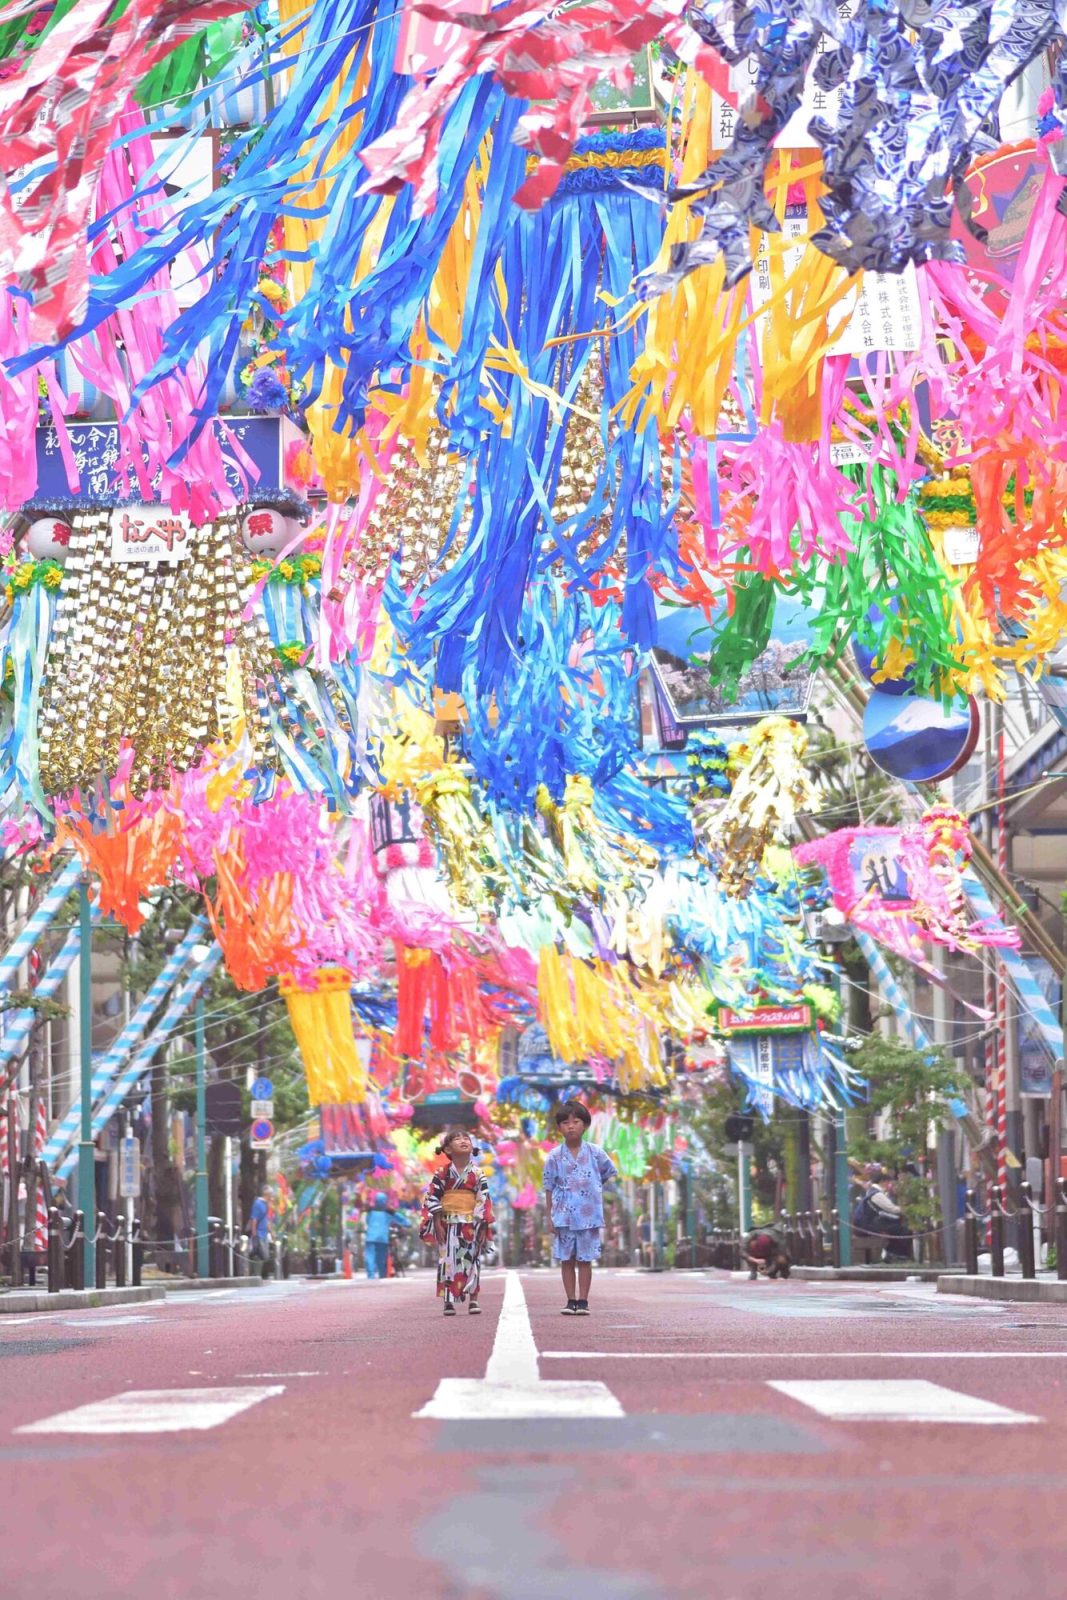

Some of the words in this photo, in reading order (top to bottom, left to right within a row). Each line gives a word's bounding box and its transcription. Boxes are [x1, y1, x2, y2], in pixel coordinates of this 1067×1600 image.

[119, 513, 187, 552] なべや
[247, 513, 273, 538] 祭
[126, 545, 161, 554] 生活の道具
